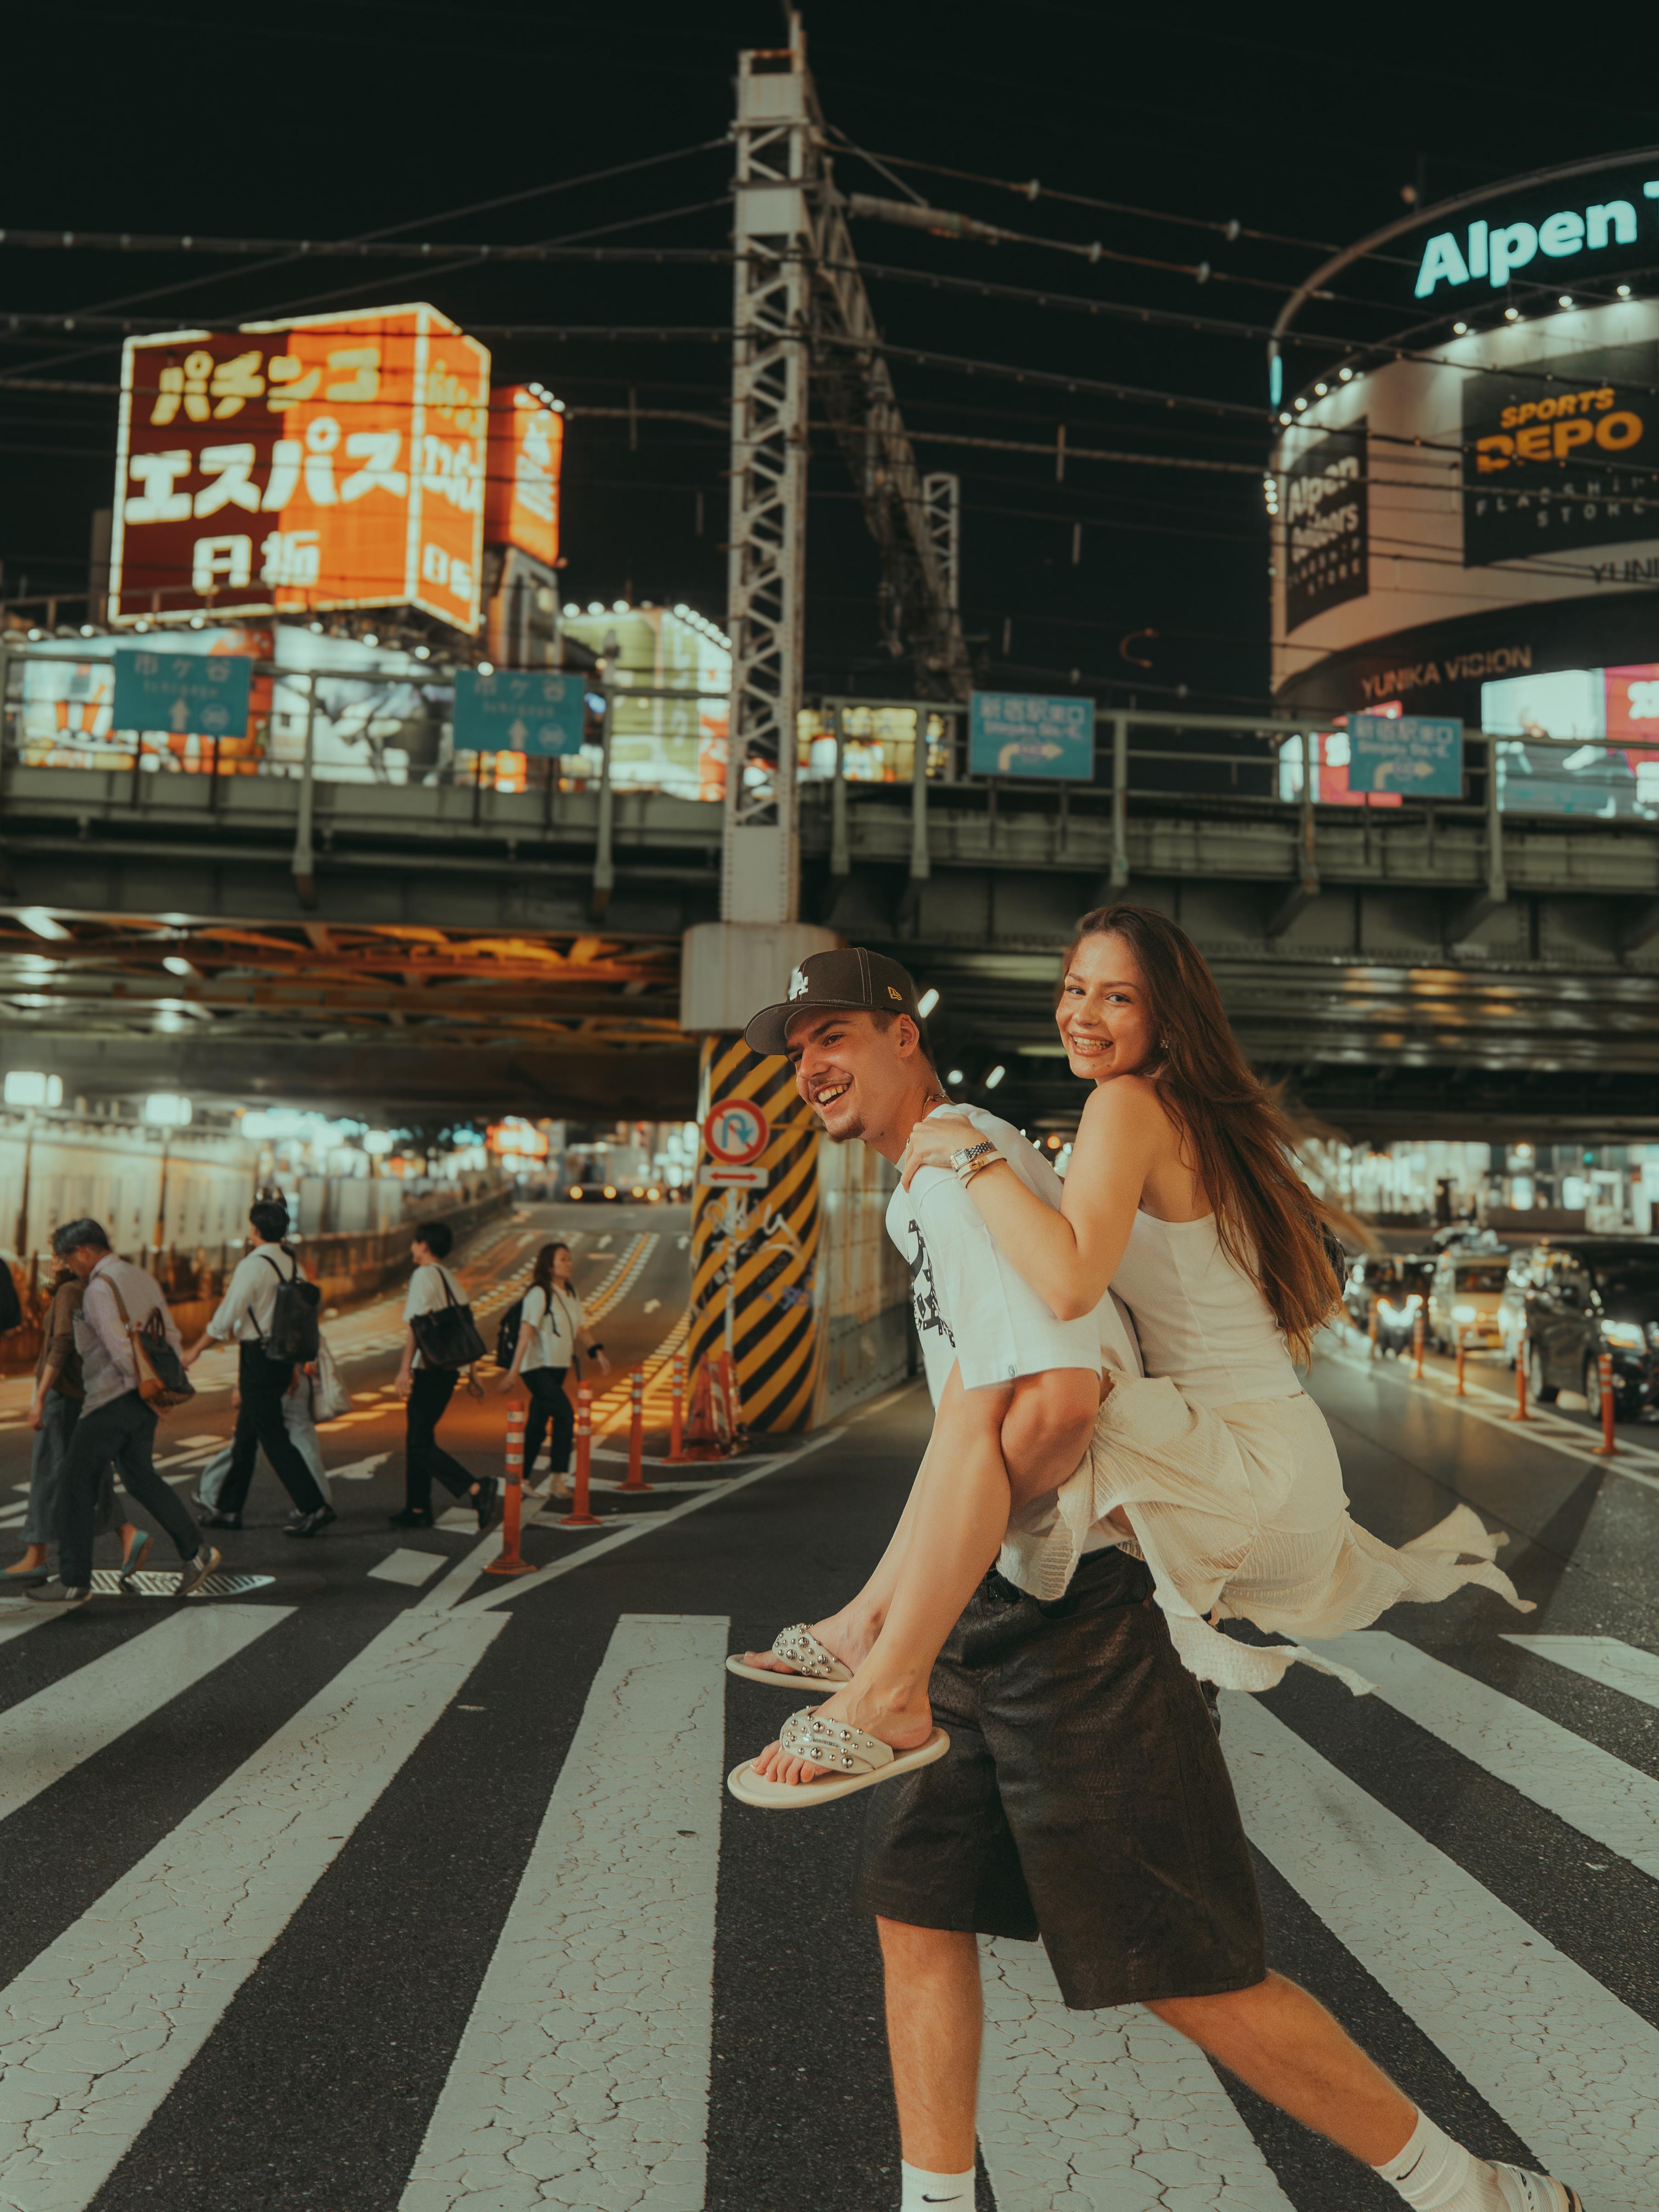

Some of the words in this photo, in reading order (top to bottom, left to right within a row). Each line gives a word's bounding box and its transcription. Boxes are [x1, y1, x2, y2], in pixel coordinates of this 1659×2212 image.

[1414, 200, 1637, 299] Alpen
[150, 348, 381, 424] パチンコ
[1500, 387, 1615, 429] SPORTS
[124, 416, 408, 525] エスパス
[1476, 411, 1644, 474] DEPO
[1360, 661, 1440, 700] YUNIKA
[1445, 646, 1531, 680] VISION
